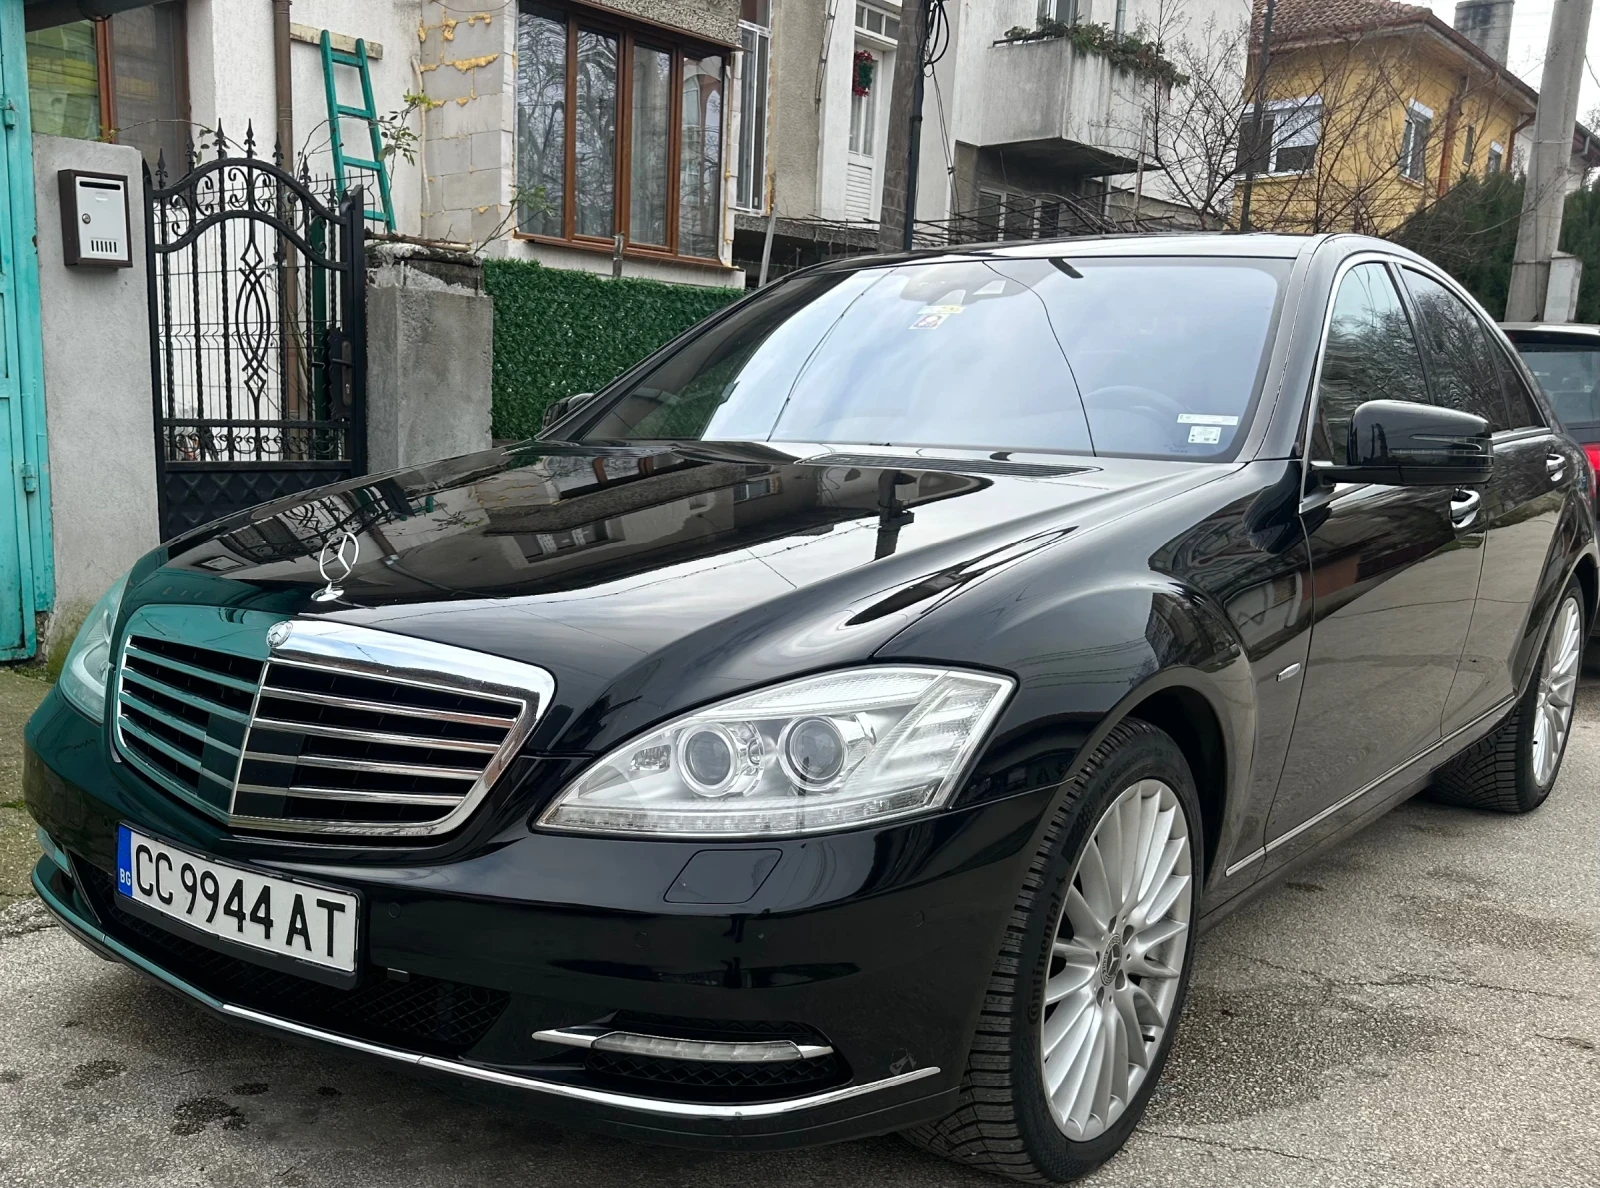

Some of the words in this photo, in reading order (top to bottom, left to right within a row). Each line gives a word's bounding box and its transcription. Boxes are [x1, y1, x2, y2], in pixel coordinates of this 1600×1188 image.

[119, 867, 132, 886] BG
[135, 844, 173, 905] CC
[180, 862, 273, 940] 9944
[285, 893, 346, 957] AT
[1027, 891, 1062, 1025] Continental
